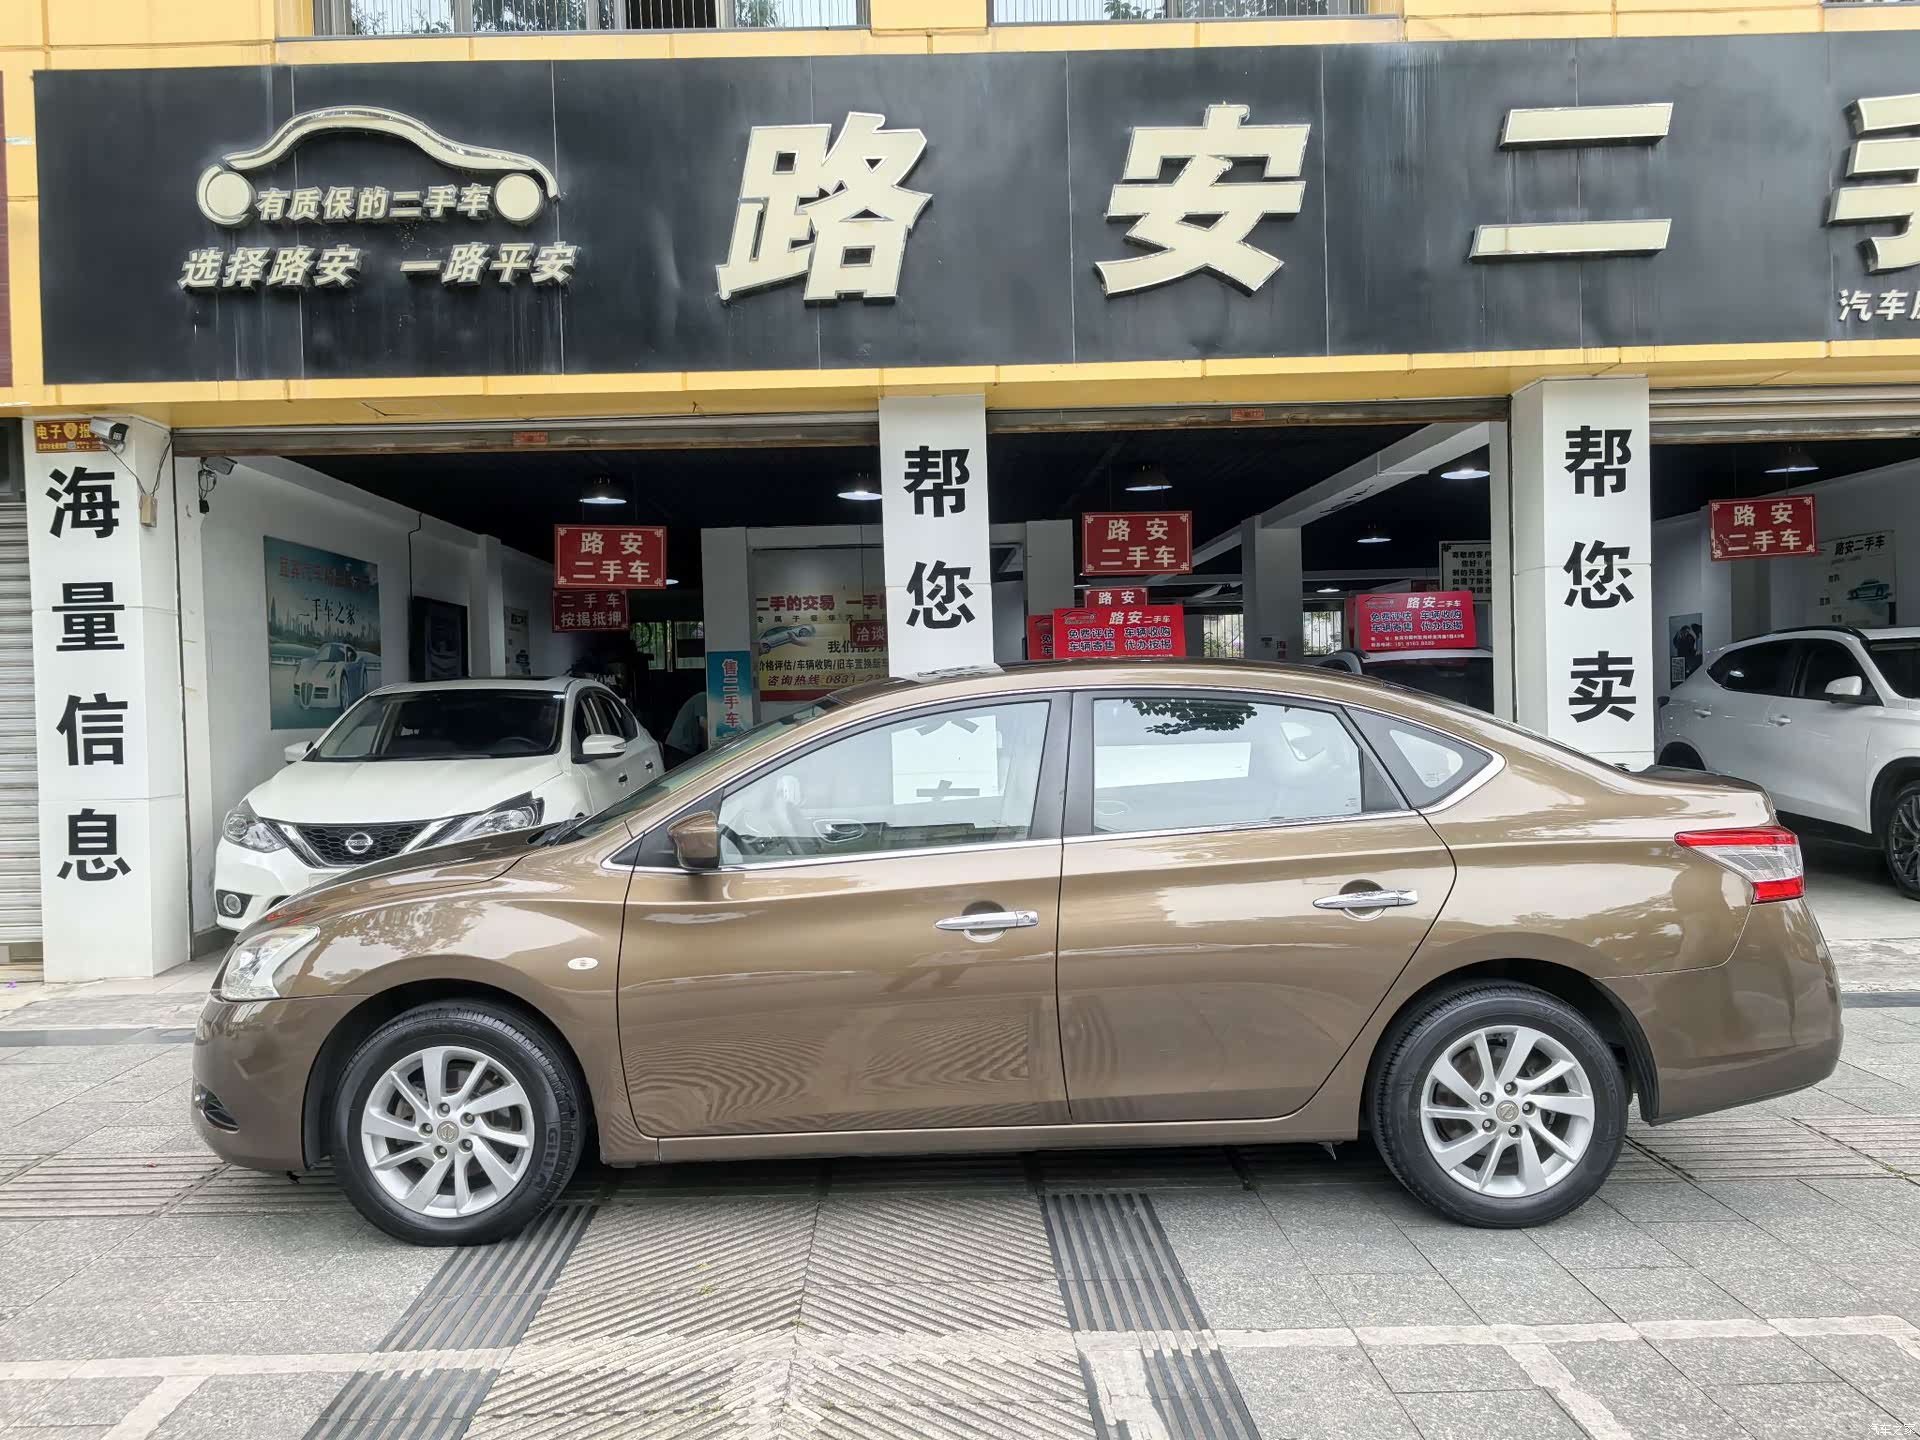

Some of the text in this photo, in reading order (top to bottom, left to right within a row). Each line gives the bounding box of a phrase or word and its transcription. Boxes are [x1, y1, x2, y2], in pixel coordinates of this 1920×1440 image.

[256, 183, 492, 222] 有质保的二手车
[179, 241, 580, 290] 选择路安 一路平安
[37, 424, 61, 439] 电子
[1733, 502, 1794, 527] 路安
[1107, 518, 1170, 542] 路安
[1728, 529, 1802, 553] 二手车
[580, 532, 644, 556] 路安
[1100, 545, 1177, 568] 二手车
[572, 560, 651, 583] 二手车
[1564, 425, 1637, 724] 帮您卖
[561, 592, 621, 609] 二手车
[756, 595, 835, 611] 二手的交易
[1098, 590, 1136, 606] 路安
[560, 609, 623, 628] 按揭抵押
[1109, 611, 1171, 625] 路安二手车
[1068, 626, 1171, 639] 免费评估 车辆收购
[1068, 639, 1172, 652] 车辆寄售 代办按揭
[45, 466, 132, 882] 海量信息
[722, 659, 740, 728] 售二手车
